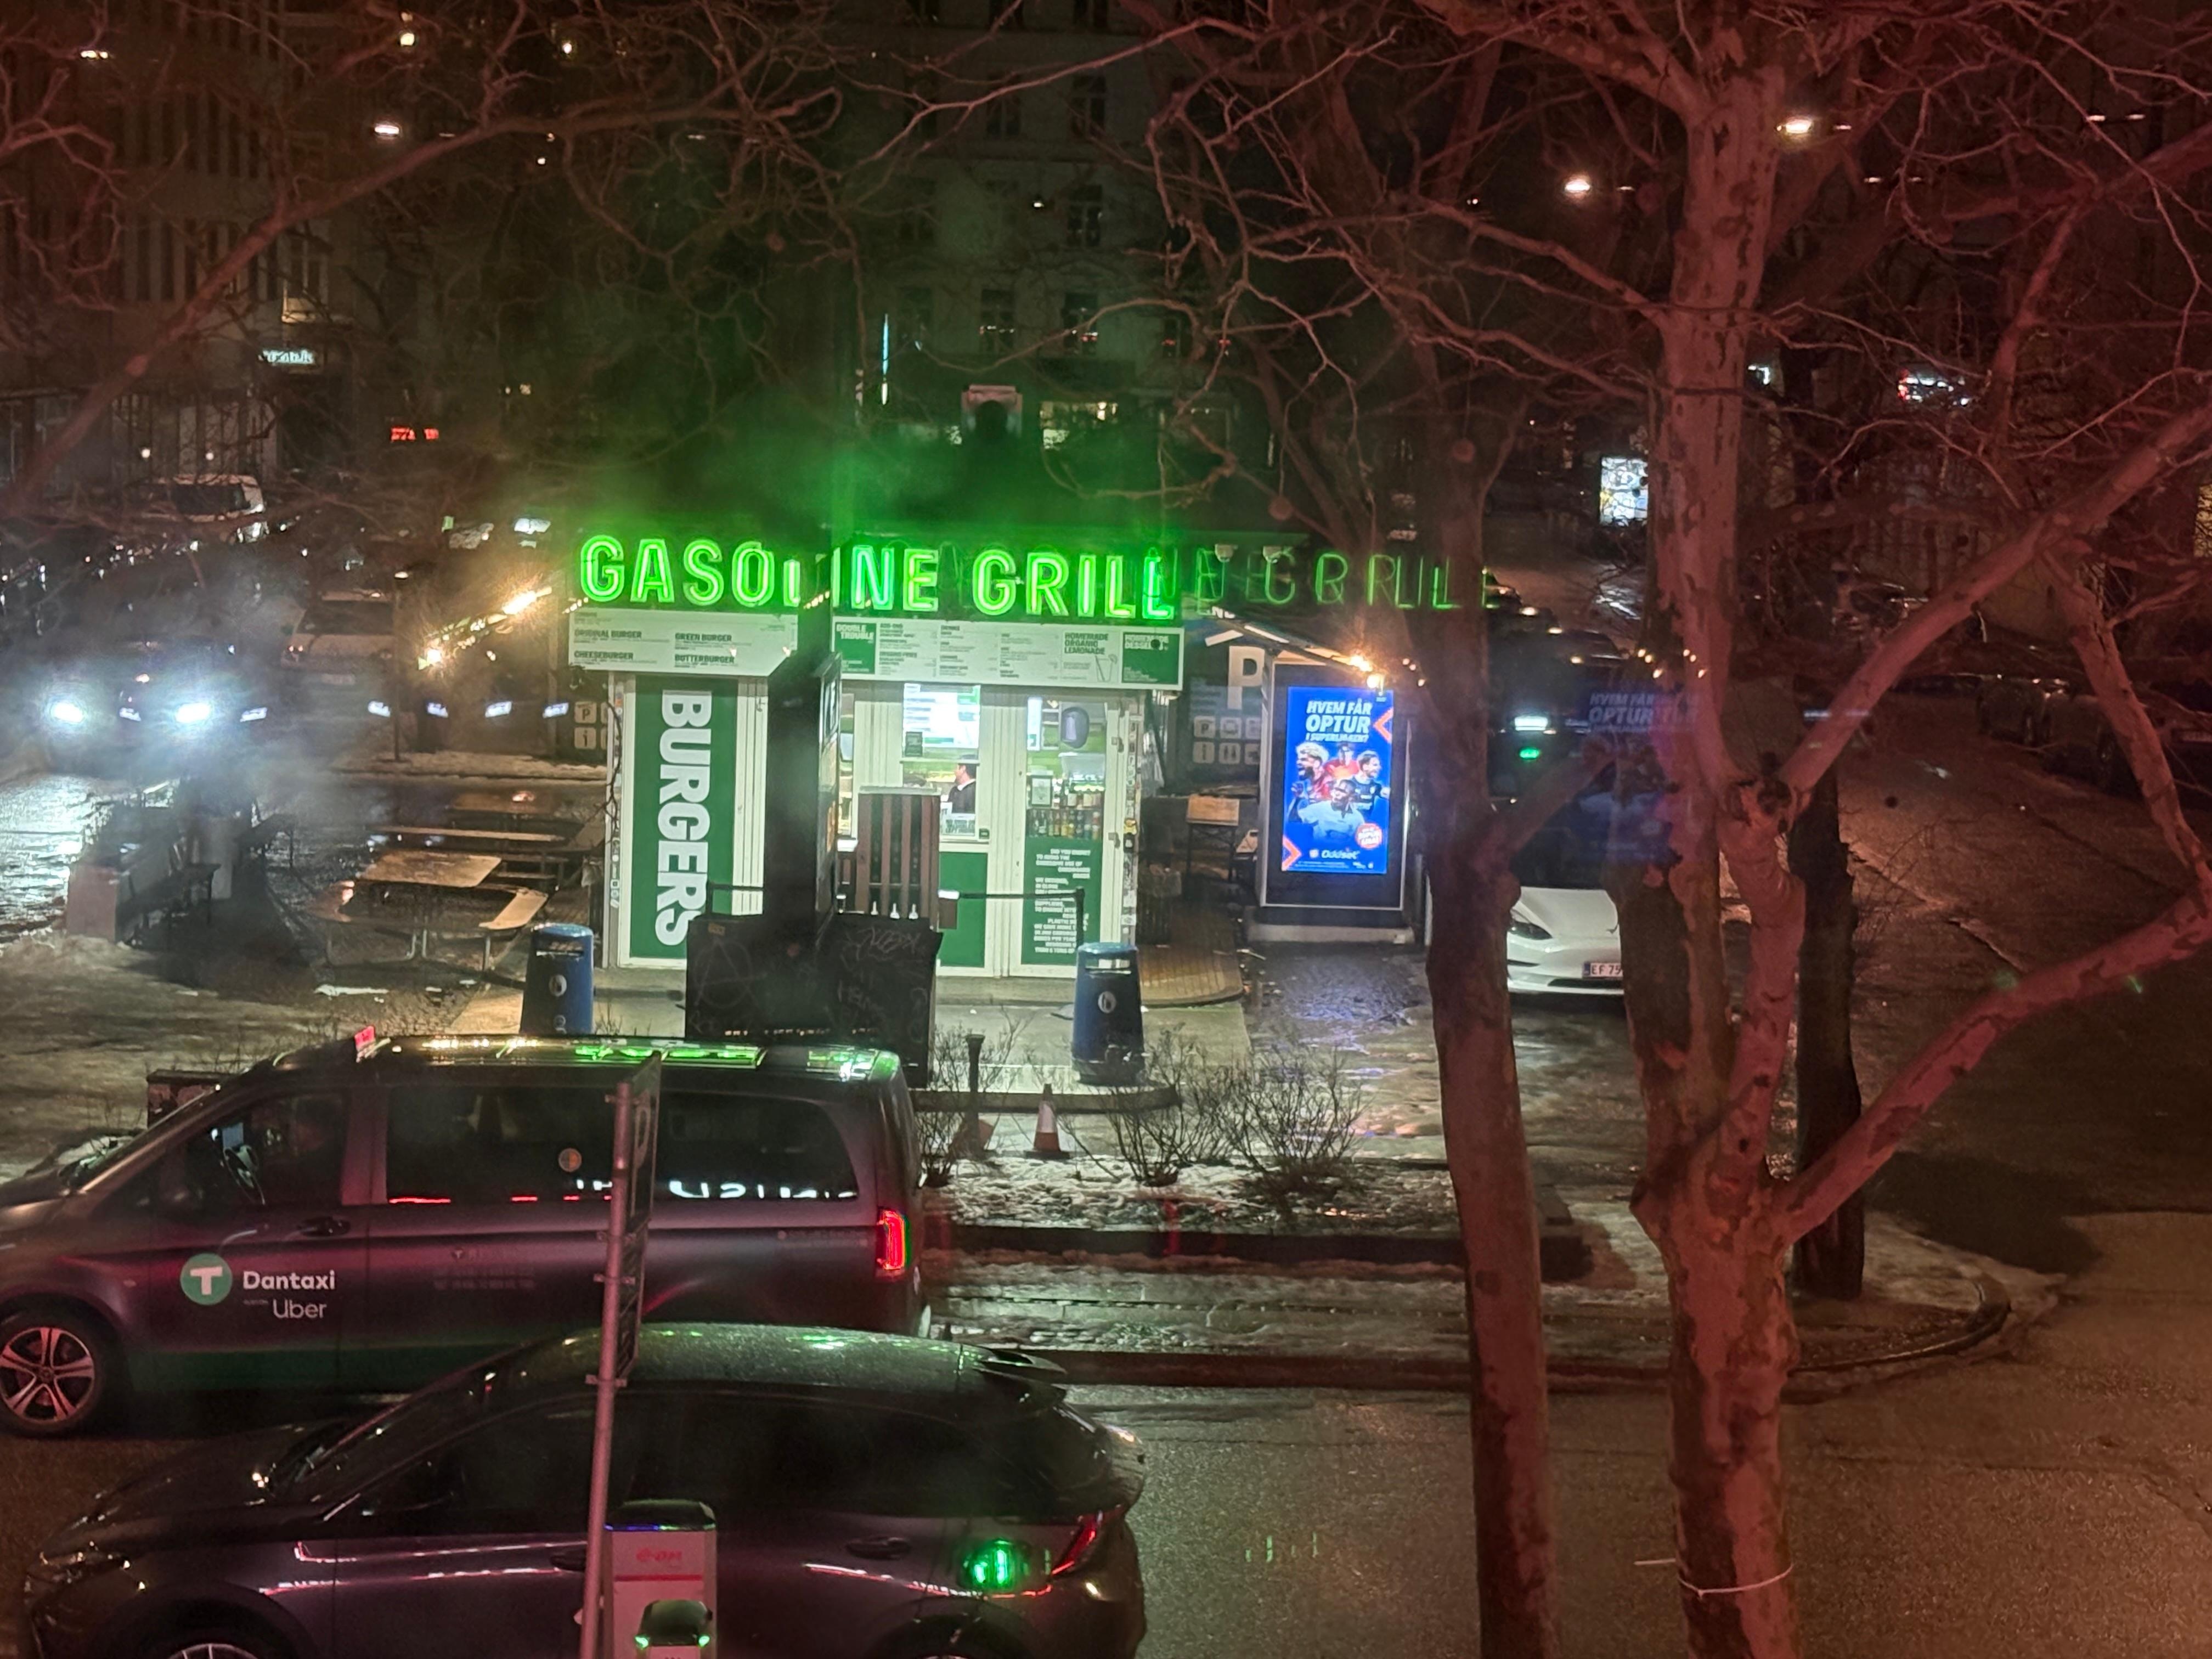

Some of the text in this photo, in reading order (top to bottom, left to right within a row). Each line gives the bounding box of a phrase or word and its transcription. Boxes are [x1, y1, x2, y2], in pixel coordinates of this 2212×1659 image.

[972, 549, 1174, 620] GRILL
[611, 630, 641, 639] BURGER
[840, 632, 874, 640] TROUBLE
[574, 651, 634, 660] CHEESEBURGER
[1064, 646, 1105, 654] LEMONADE
[675, 654, 735, 664] BUTTERBURGER
[1306, 697, 1373, 715] HVEM FÅR
[1305, 714, 1371, 734] OPTUR
[655, 691, 712, 946] BURGERS
[1592, 964, 1604, 975] EF
[243, 1269, 335, 1290] Dantaxi
[273, 1298, 327, 1319] Uber
